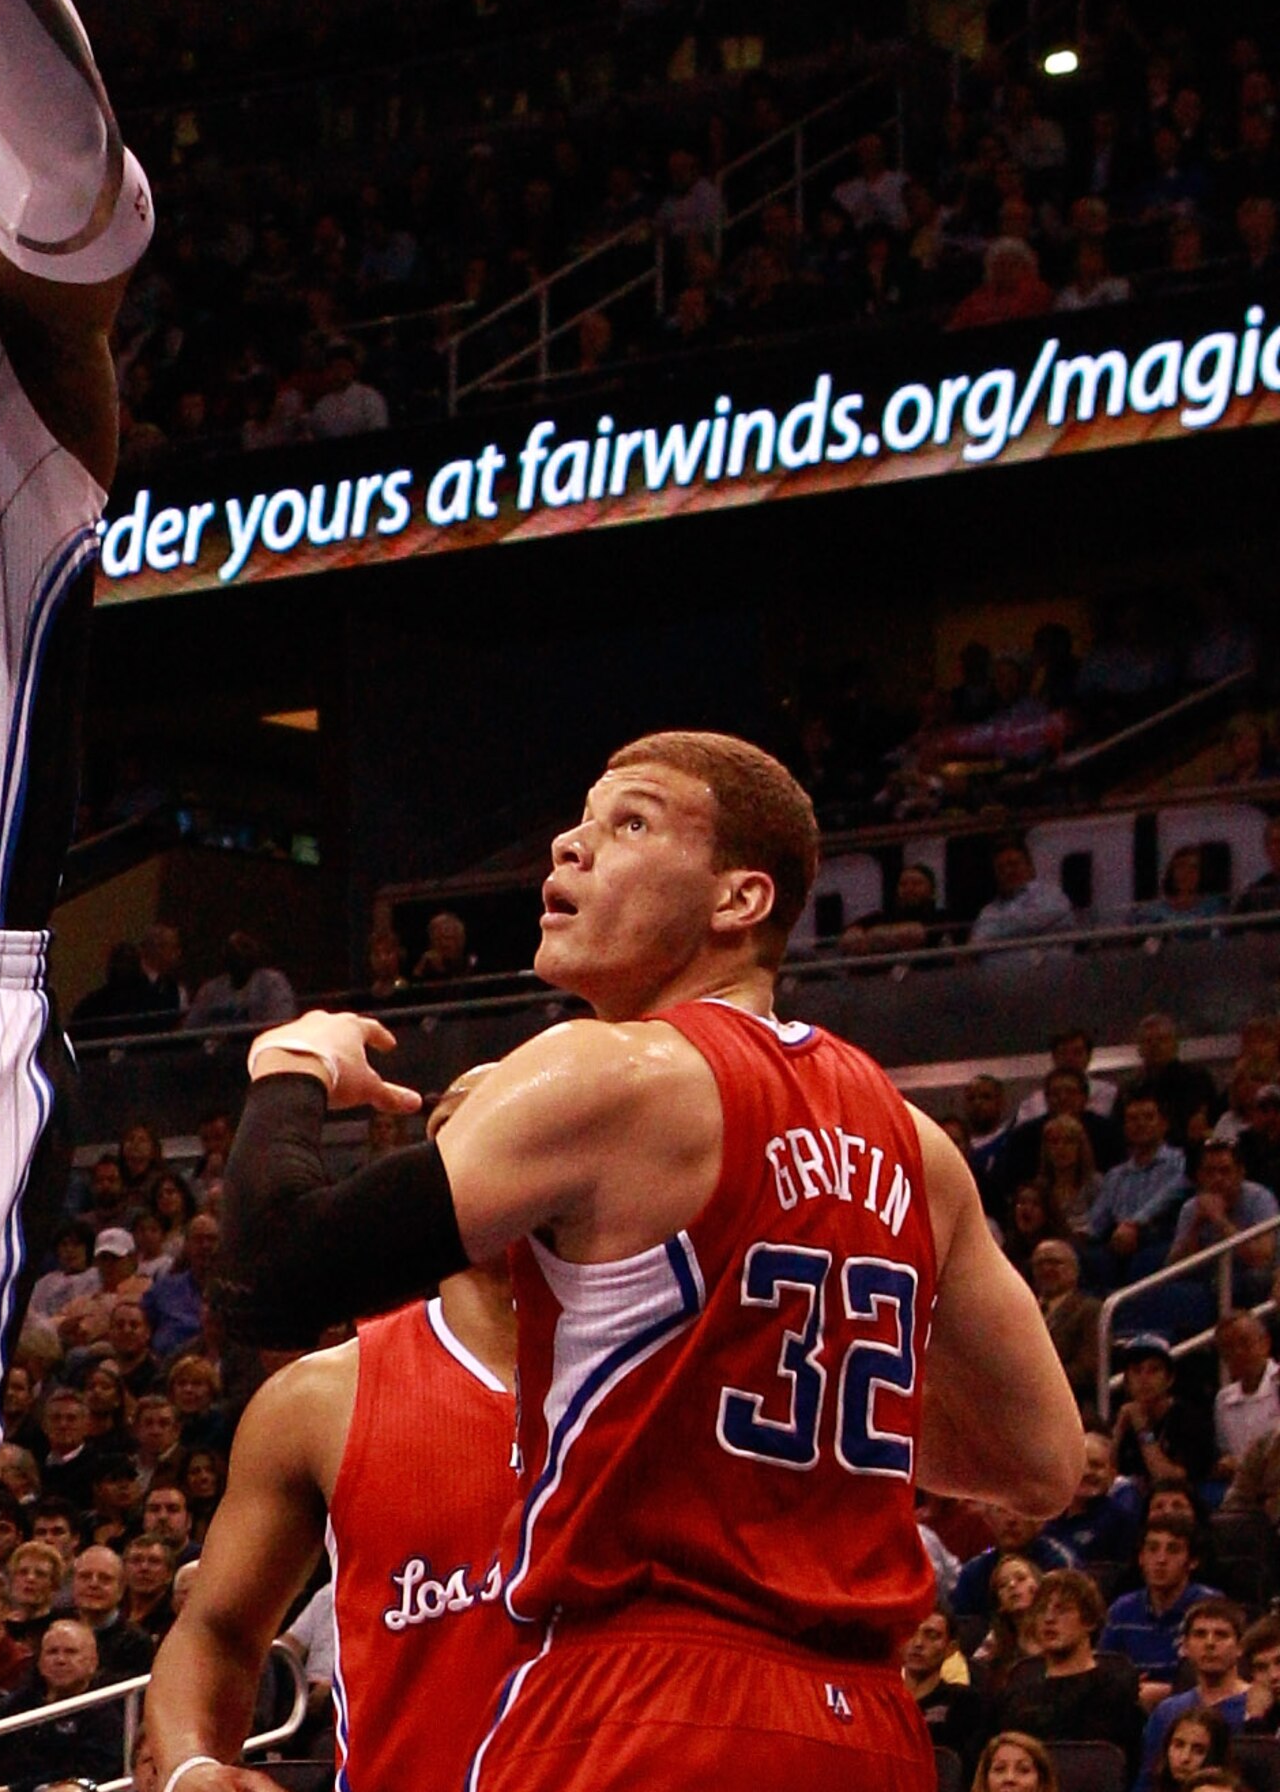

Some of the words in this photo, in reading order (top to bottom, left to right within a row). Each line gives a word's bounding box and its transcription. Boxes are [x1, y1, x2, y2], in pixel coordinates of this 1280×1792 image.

[218, 469, 411, 585] yours
[426, 444, 506, 525] at
[716, 1238, 918, 1480] 32
[384, 1558, 475, 1631] Los
